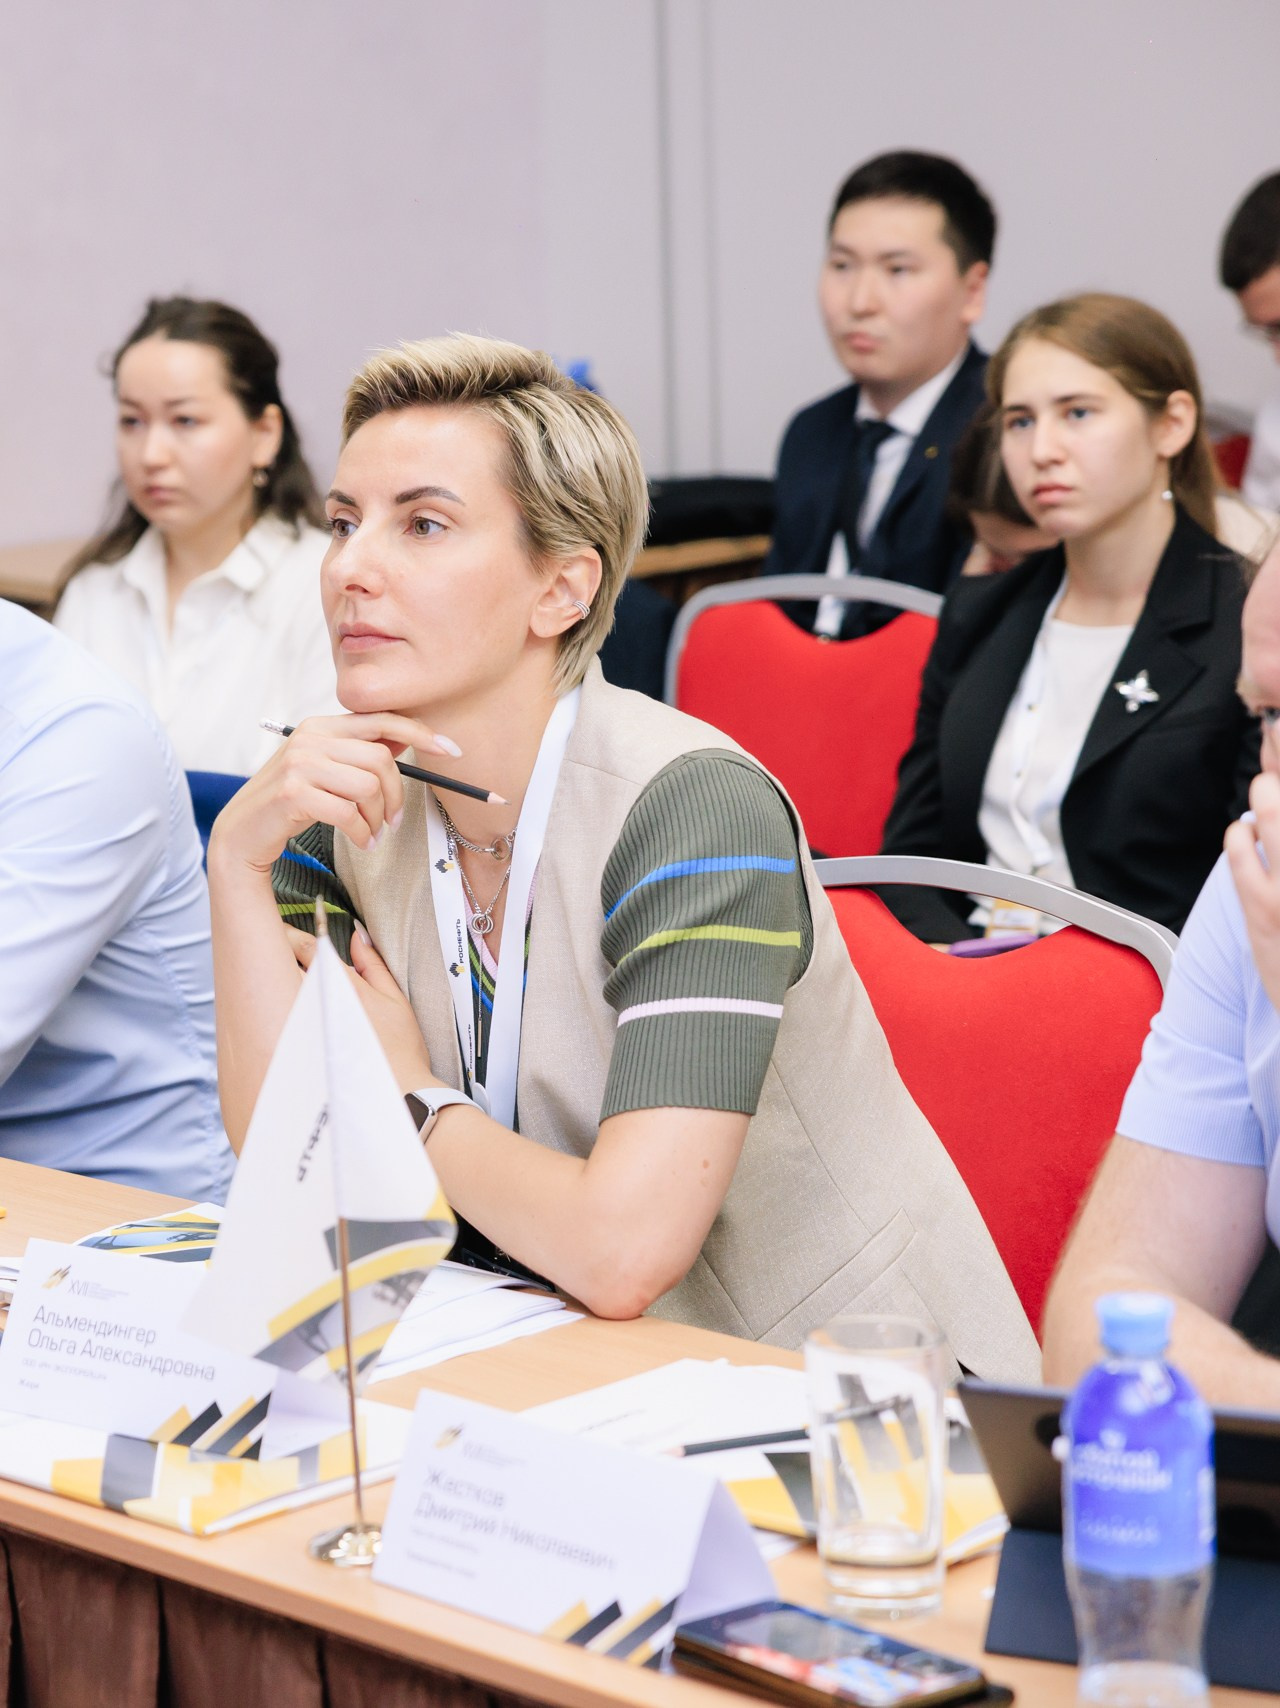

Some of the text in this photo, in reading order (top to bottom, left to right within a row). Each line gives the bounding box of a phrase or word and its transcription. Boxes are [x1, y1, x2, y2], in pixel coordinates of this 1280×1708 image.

[456, 918, 464, 964] РОСНЕФТЬ
[68, 1279, 89, 1297] XVII
[33, 1304, 157, 1346] Альмендингер
[27, 1327, 77, 1356] Ольга
[81, 1338, 217, 1381] Александровна
